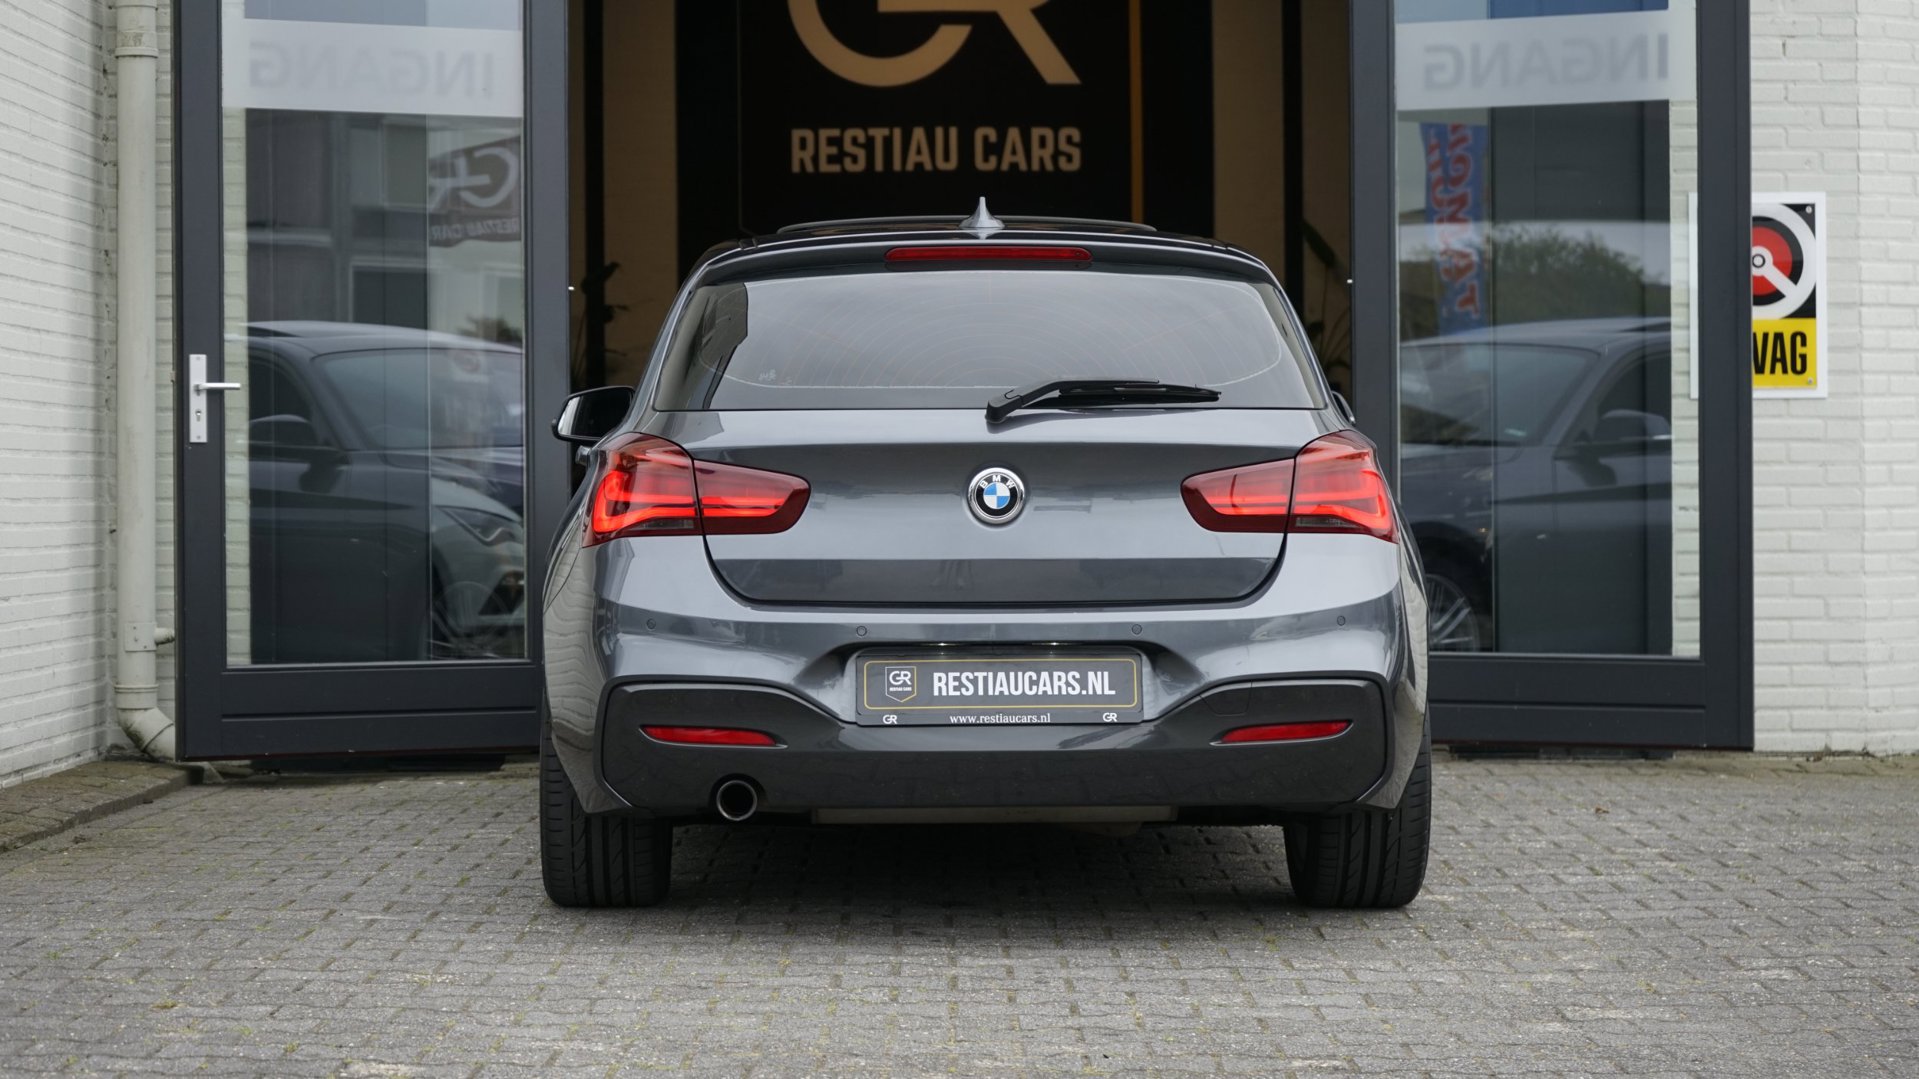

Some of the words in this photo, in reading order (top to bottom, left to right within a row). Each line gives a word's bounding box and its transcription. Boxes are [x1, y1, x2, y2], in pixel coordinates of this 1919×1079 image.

[791, 126, 958, 173] RESTIAU
[974, 126, 1081, 171] CARS
[1752, 331, 1807, 375] VAG
[980, 475, 1015, 489] BMW
[889, 670, 912, 686] GR
[933, 671, 1116, 697] RESTIAUCARS.NL
[950, 712, 1051, 724] www.restiaucars.nl
